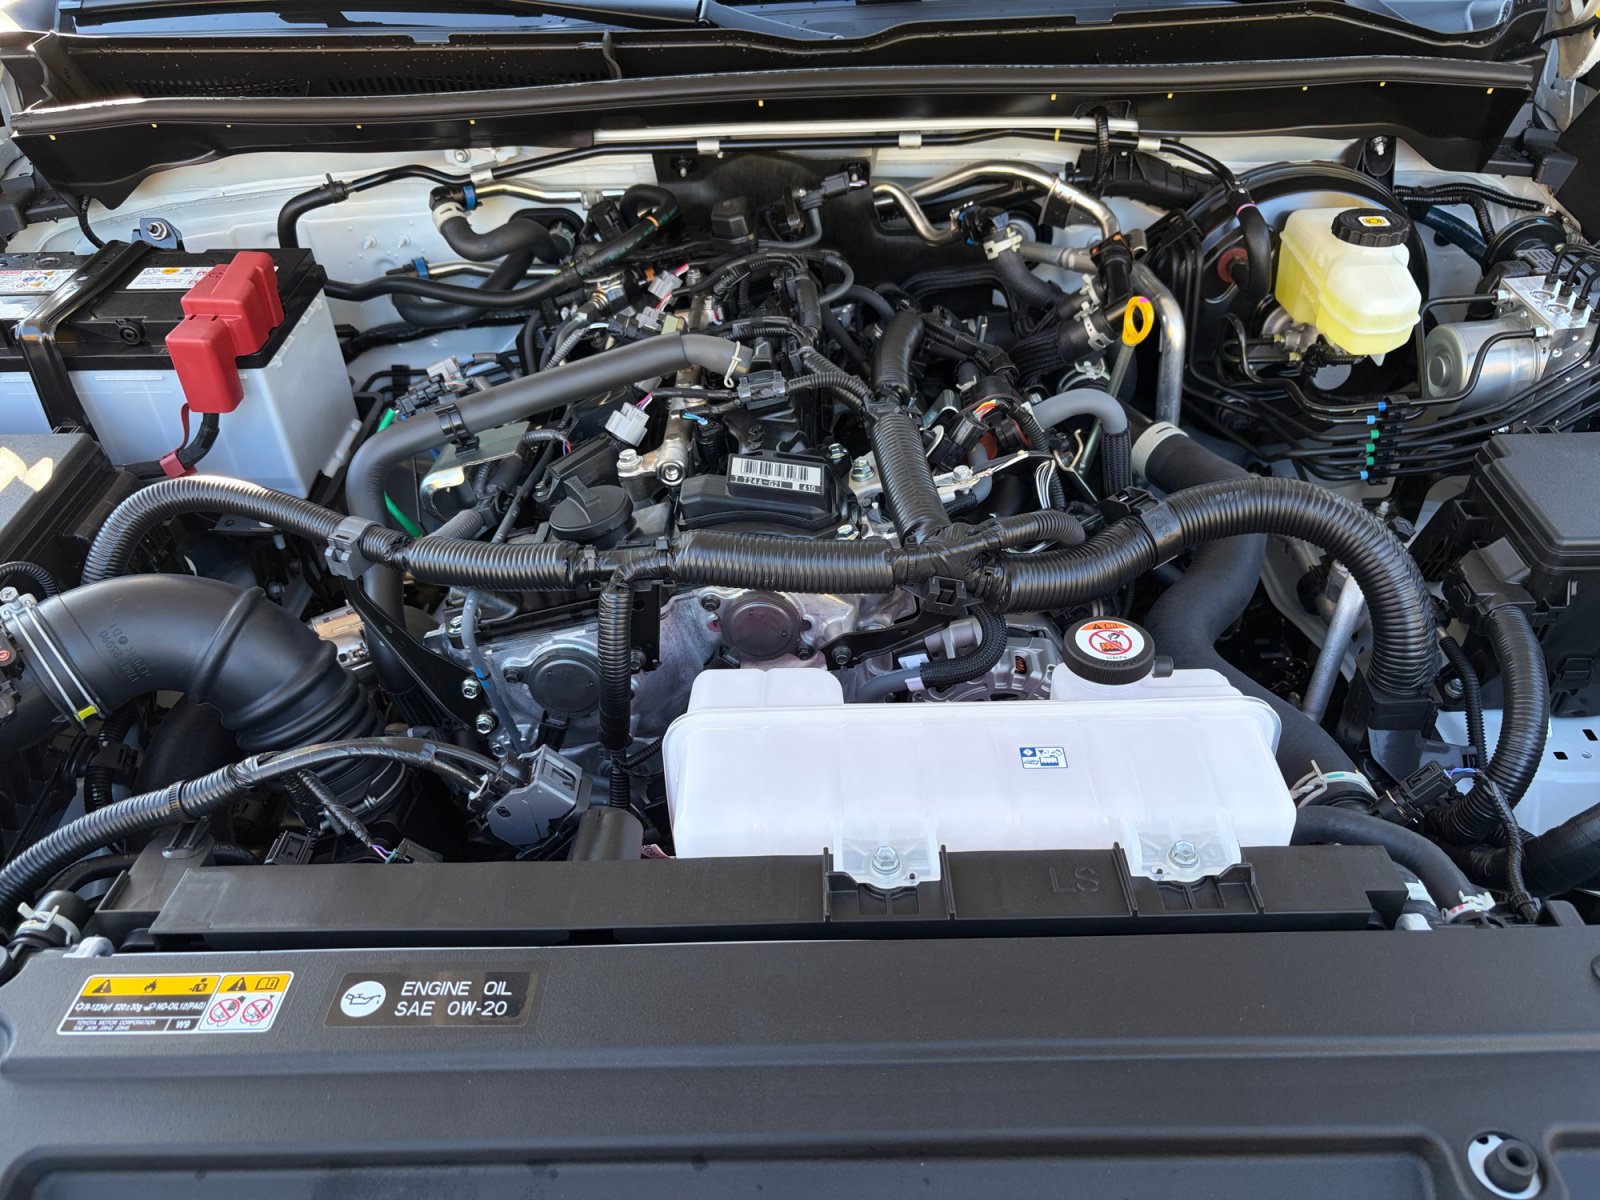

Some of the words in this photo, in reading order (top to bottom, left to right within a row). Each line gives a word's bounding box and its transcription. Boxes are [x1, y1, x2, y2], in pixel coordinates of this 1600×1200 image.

[1048, 866, 1099, 893] LS
[401, 981, 472, 996] ENGINE
[484, 981, 512, 996] OIL
[394, 1001, 435, 1016] SAE
[447, 1001, 508, 1016] 0W-20
[175, 1020, 191, 1029] W9
